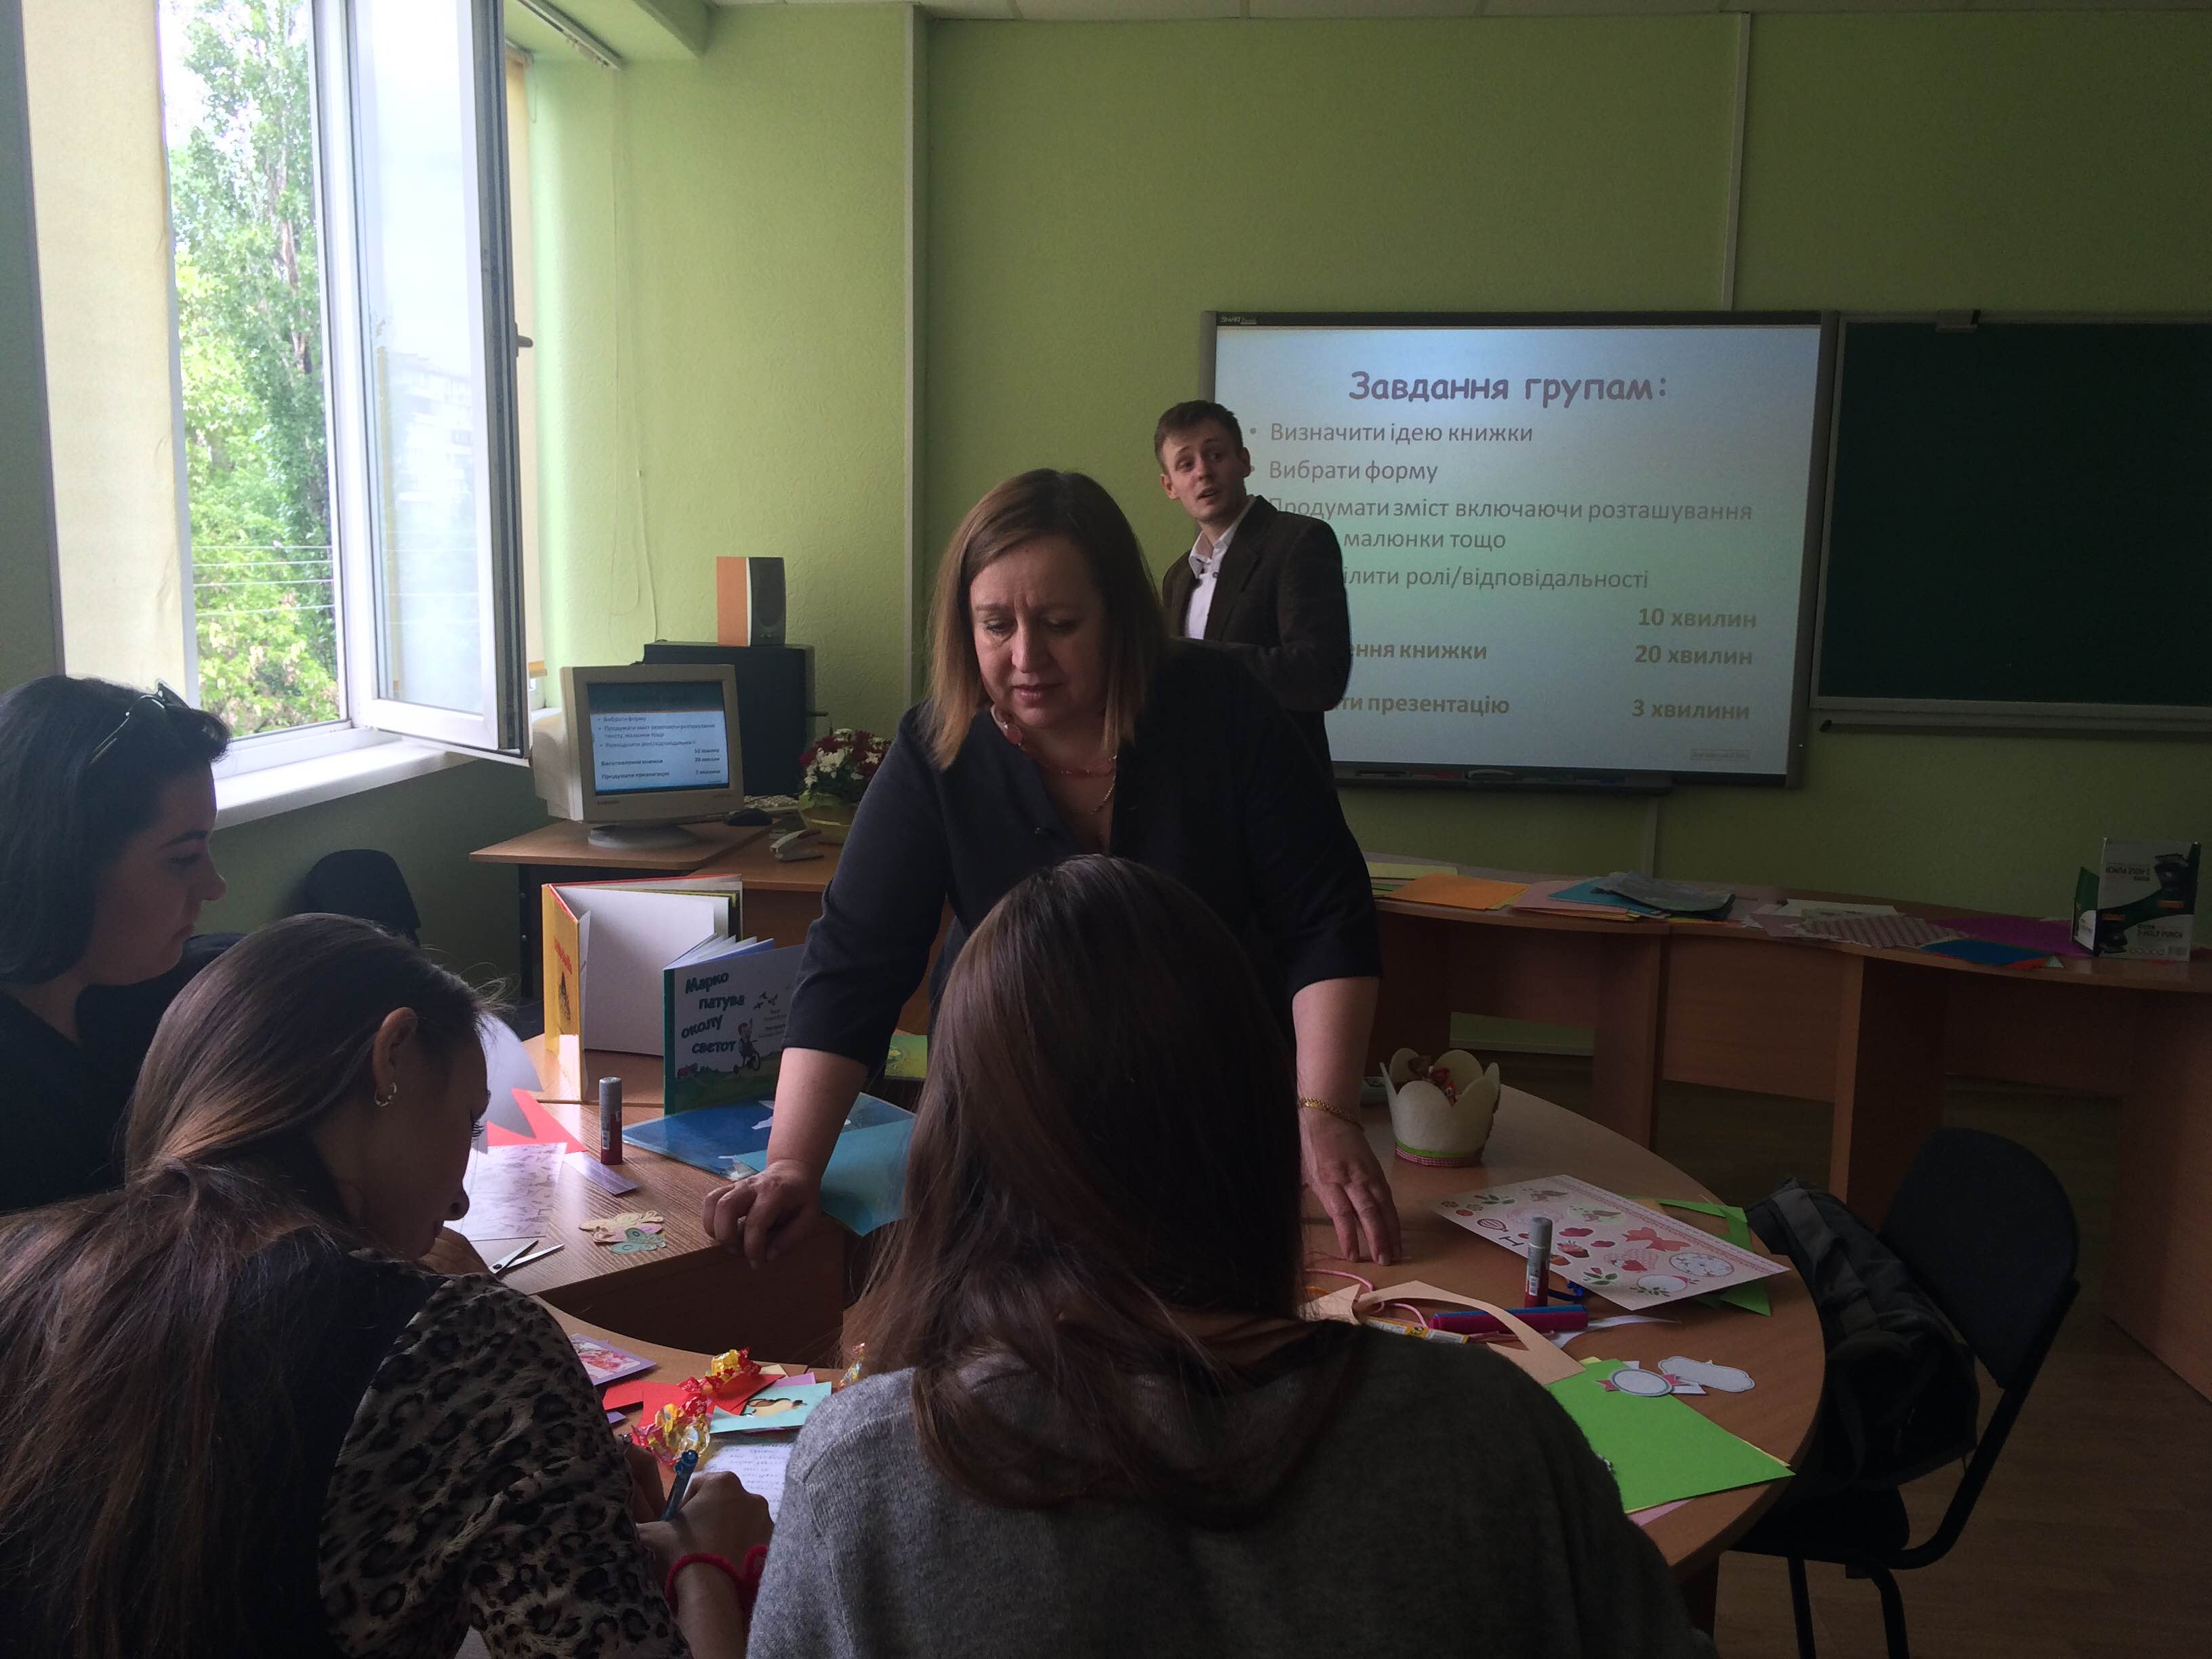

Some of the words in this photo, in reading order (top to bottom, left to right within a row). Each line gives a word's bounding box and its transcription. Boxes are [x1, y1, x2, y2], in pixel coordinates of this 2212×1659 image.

[1349, 371, 1509, 403] Завдання
[1525, 377, 1666, 409] групам:
[1271, 422, 1385, 441] Визначити
[1390, 423, 1443, 445] ідею
[1448, 427, 1533, 442] книжки
[1269, 459, 1360, 483] Вибрати
[1364, 460, 1439, 484] форму
[1393, 498, 1449, 517] зміст
[1456, 501, 1583, 518] включаючи
[1588, 503, 1753, 523] розташування
[1343, 532, 1444, 548] малюнки
[1450, 533, 1507, 552] тощо
[1344, 567, 1399, 585] ілити
[1406, 565, 1649, 591] ролі/відповідальності
[1638, 607, 1664, 626] 10
[1670, 611, 1757, 628] хвилин
[1399, 644, 1488, 660] книжки
[1634, 644, 1662, 663] 20
[1667, 649, 1753, 665] хвилин
[1367, 695, 1511, 716] презентацію
[1632, 699, 1645, 718] 3
[1650, 702, 1750, 720] хвилини
[685, 972, 729, 994] Марко
[699, 995, 745, 1011] патува
[681, 1015, 723, 1039] околу
[692, 1040, 737, 1054] светот
